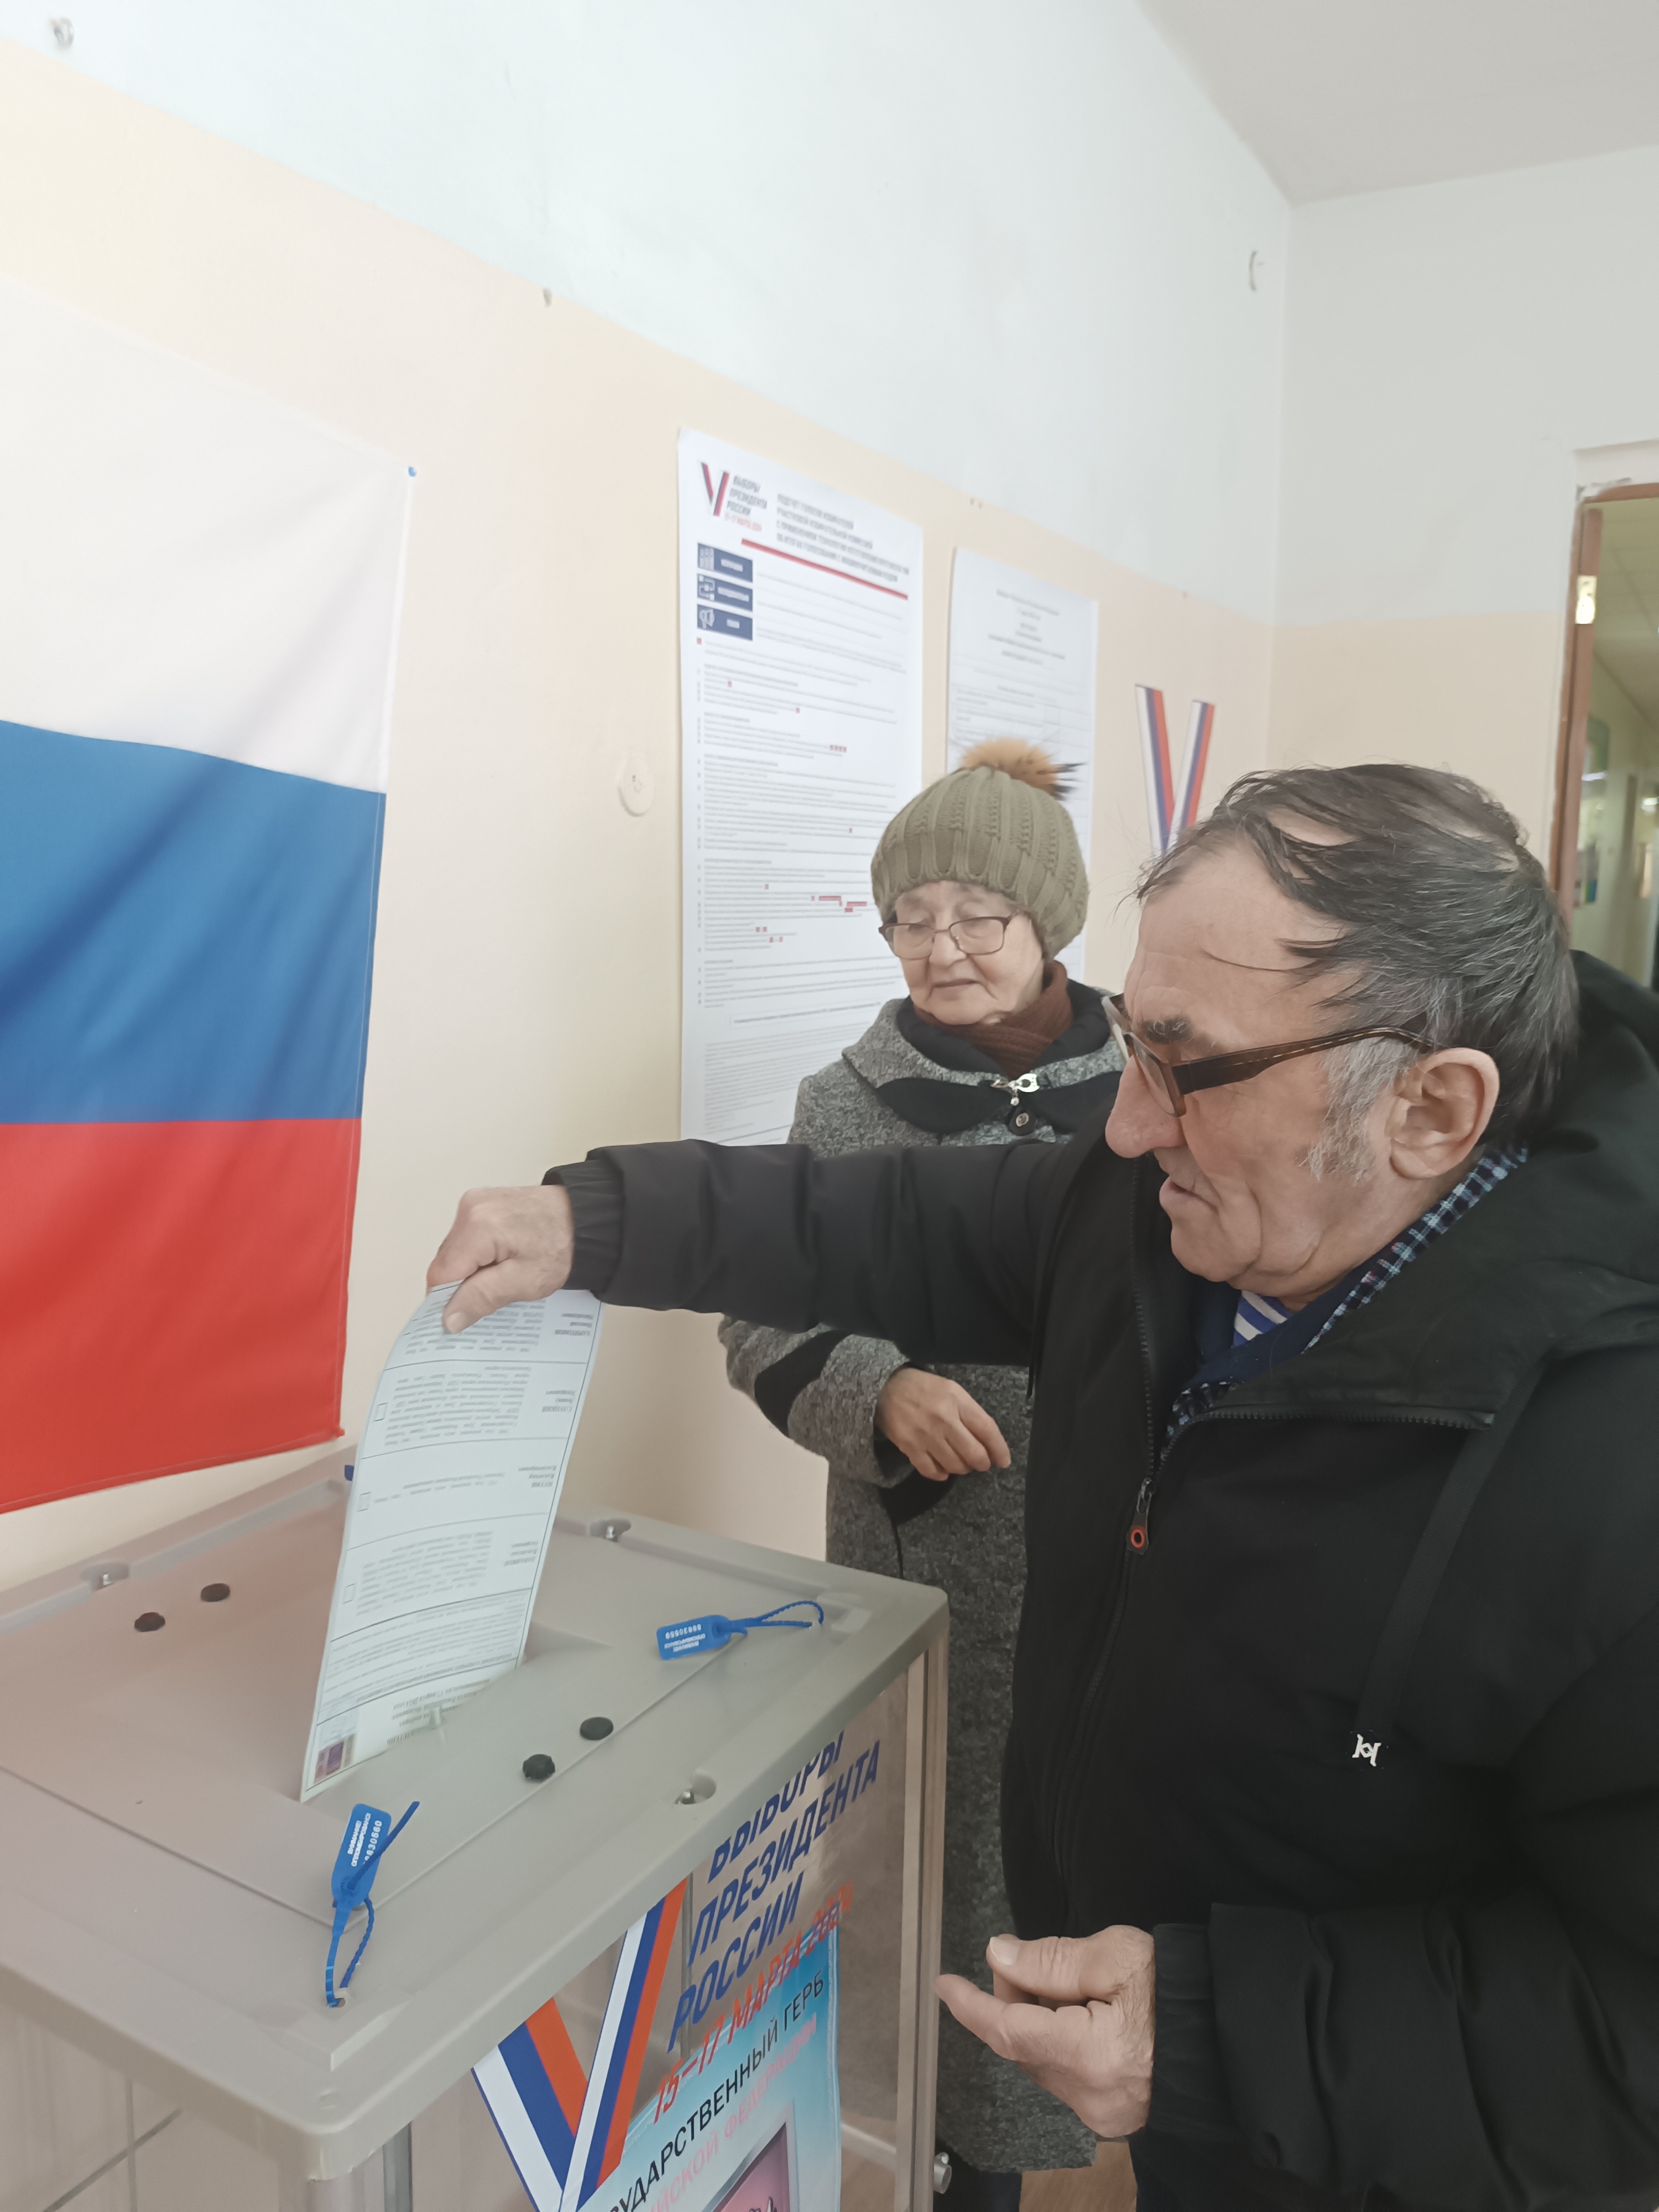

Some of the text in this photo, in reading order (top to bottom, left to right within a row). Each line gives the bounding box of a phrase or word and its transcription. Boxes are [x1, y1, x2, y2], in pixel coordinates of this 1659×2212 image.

[688, 1739, 880, 1967] ПРЕЗИДЕНТА
[667, 1871, 804, 2054] РОССИИ
[728, 1928, 802, 2045] МАРТА
[610, 1969, 824, 2212] УДАРСТВЕННЫЙ ГЕРБ
[724, 2013, 817, 2139] ФЕДЕРАЦИИ
